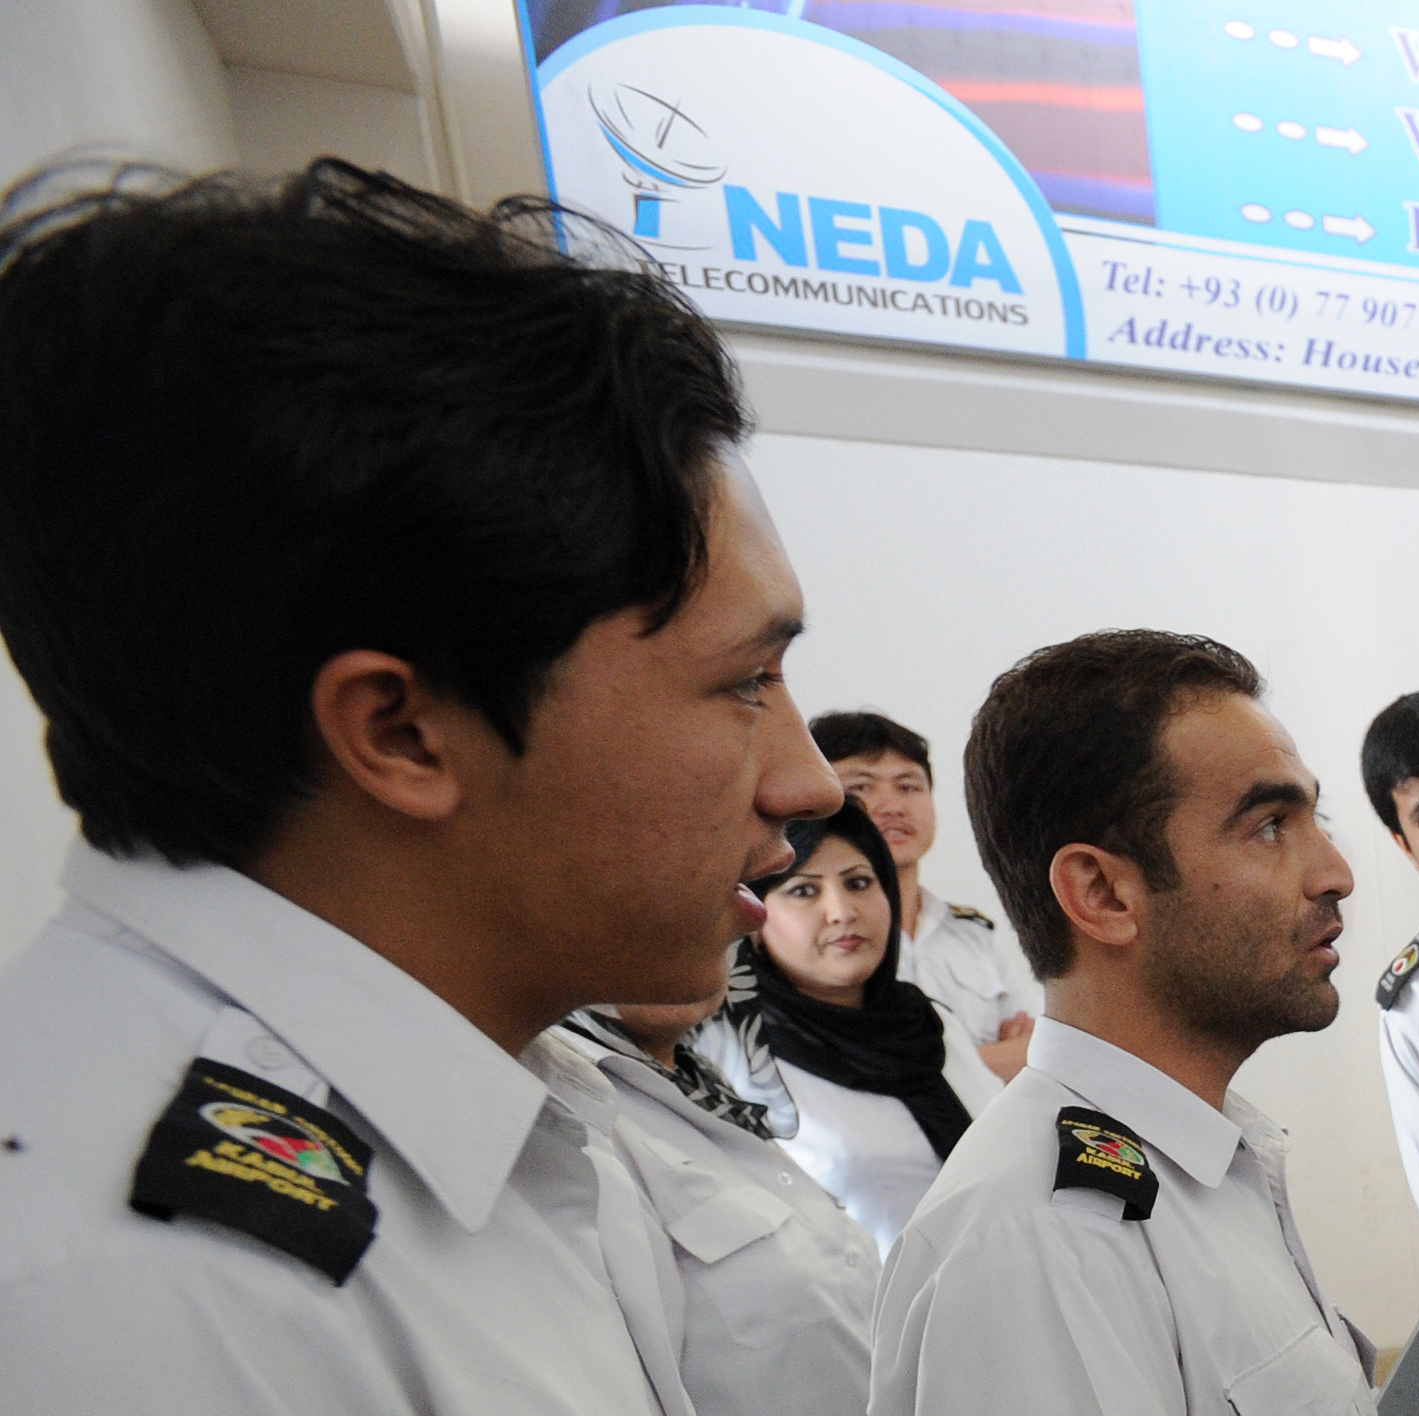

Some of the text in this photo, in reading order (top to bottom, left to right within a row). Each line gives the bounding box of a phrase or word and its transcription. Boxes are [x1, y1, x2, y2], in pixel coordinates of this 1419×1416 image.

[723, 183, 1025, 296] NEDA
[1102, 259, 1165, 298] Tel:
[1179, 276, 1242, 308] +93
[1255, 284, 1299, 320] (0)
[1315, 289, 1351, 318] 77
[1363, 297, 1418, 328] 907
[1106, 314, 1287, 364] Address:
